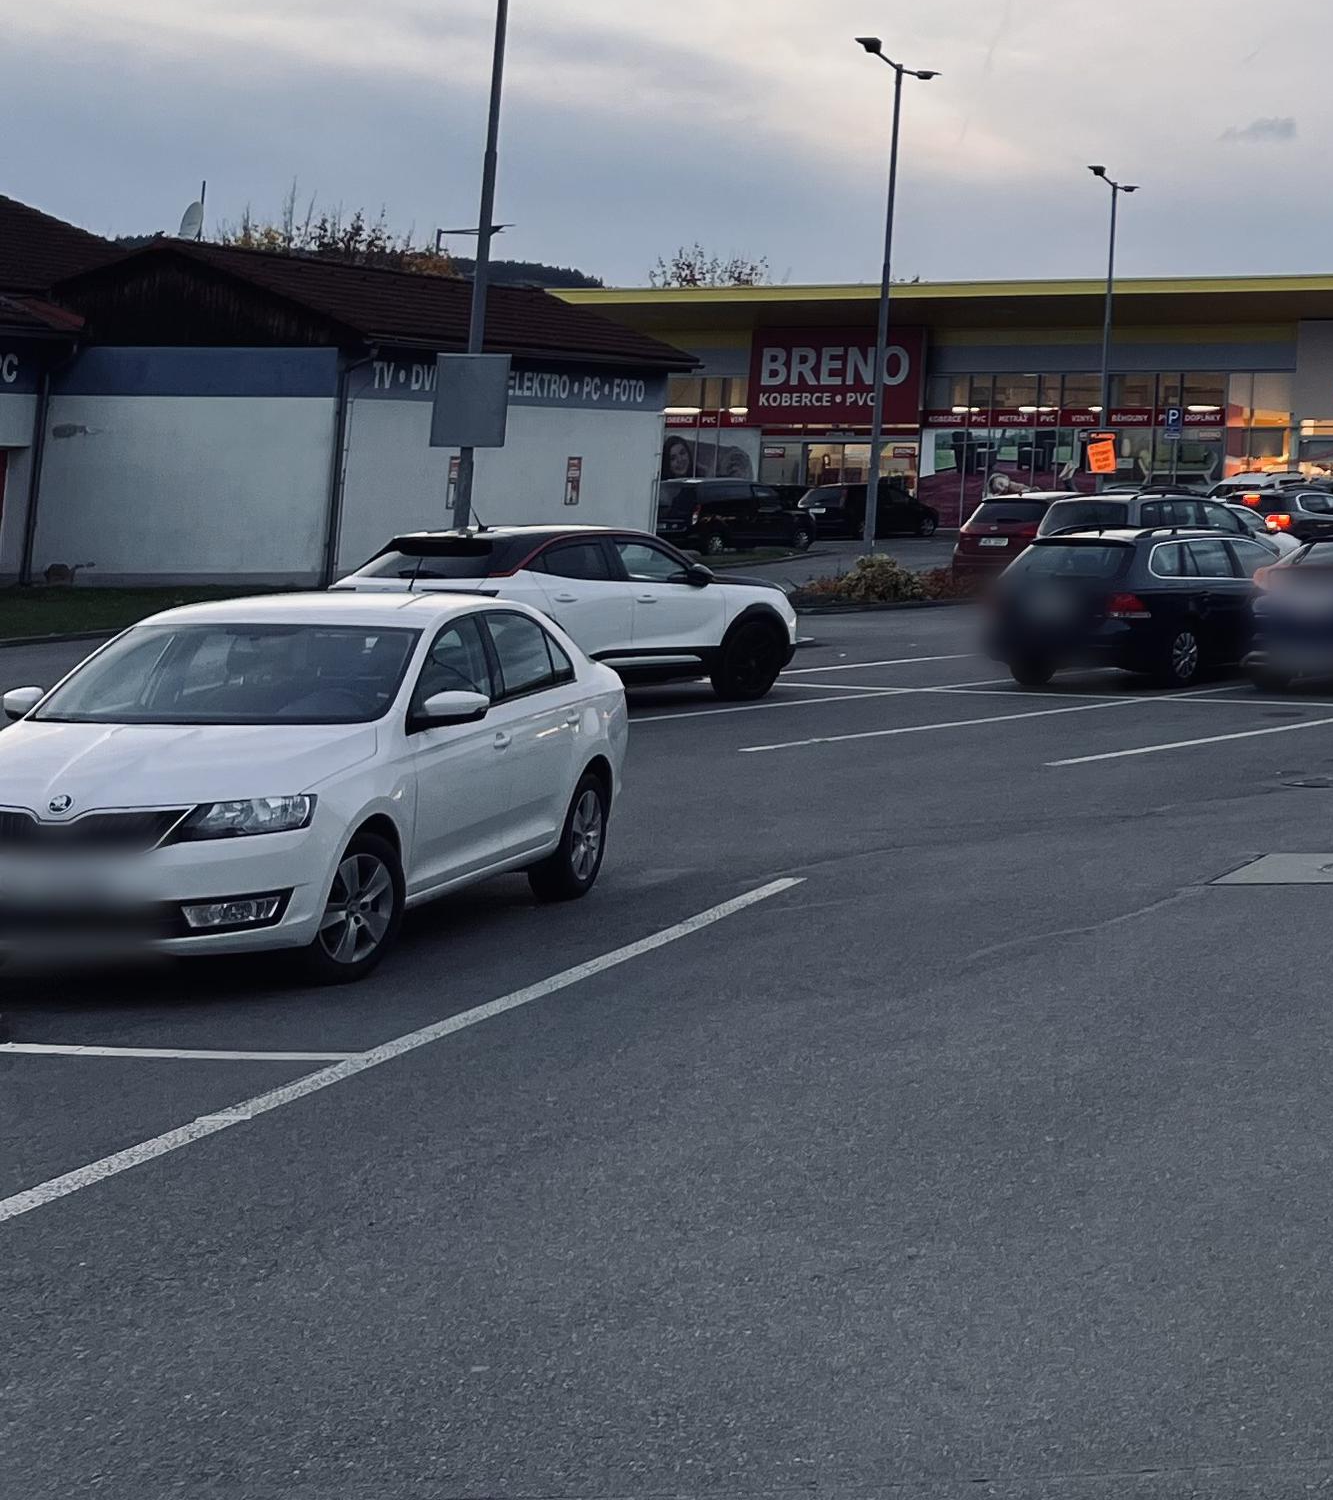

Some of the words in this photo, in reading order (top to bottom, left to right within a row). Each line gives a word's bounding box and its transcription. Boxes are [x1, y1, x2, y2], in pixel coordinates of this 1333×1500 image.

[0, 352, 18, 383] C
[760, 345, 910, 386] BRENO
[373, 361, 395, 389] TV
[582, 376, 601, 401] PC
[613, 378, 646, 402] FOTO
[758, 393, 832, 406] KOBERCE
[845, 392, 877, 406] PVC
[1169, 409, 1179, 425] P
